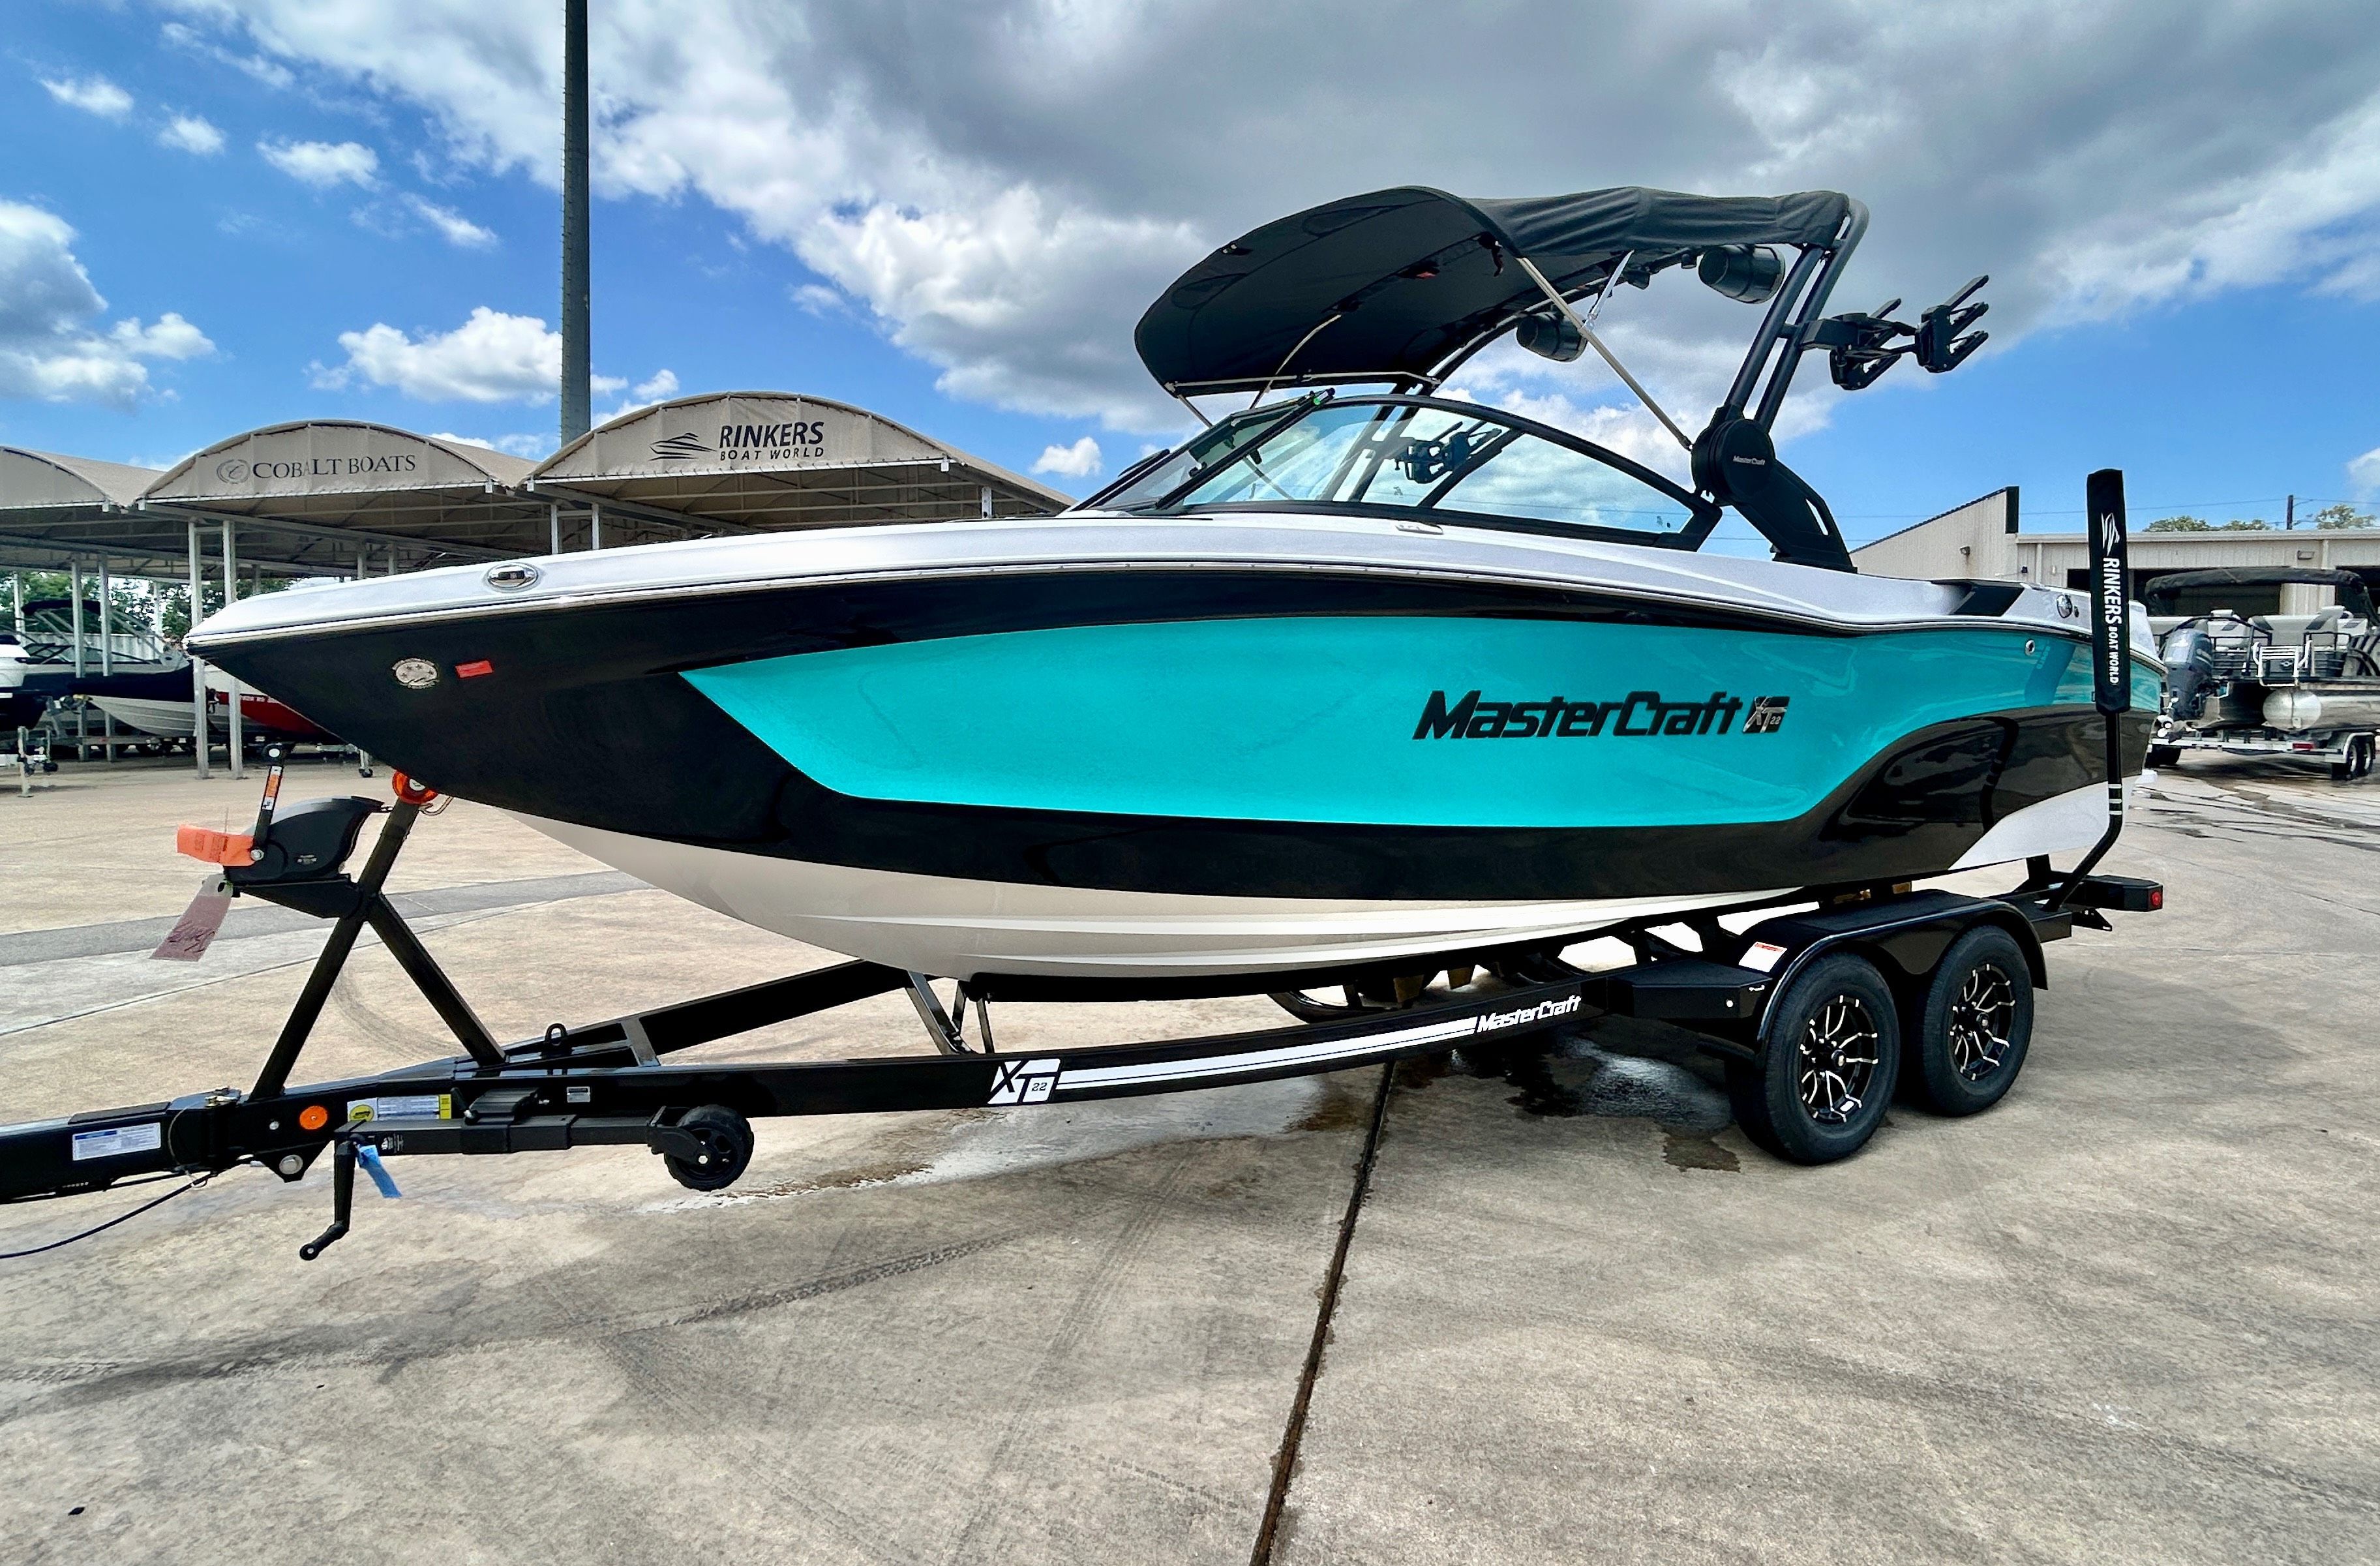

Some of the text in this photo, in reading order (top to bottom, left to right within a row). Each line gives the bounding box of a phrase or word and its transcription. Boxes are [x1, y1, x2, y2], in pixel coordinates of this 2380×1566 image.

[719, 421, 824, 448] RINKERS
[252, 455, 415, 479] COBALT BOATS
[720, 447, 824, 460] BOAT WORLD
[2103, 557, 2122, 685] RINKERS BOAT WORLD
[1412, 690, 1743, 740] MasterCraft
[1477, 995, 1582, 1033] MasterCraft
[1031, 1082, 1047, 1091] 22
